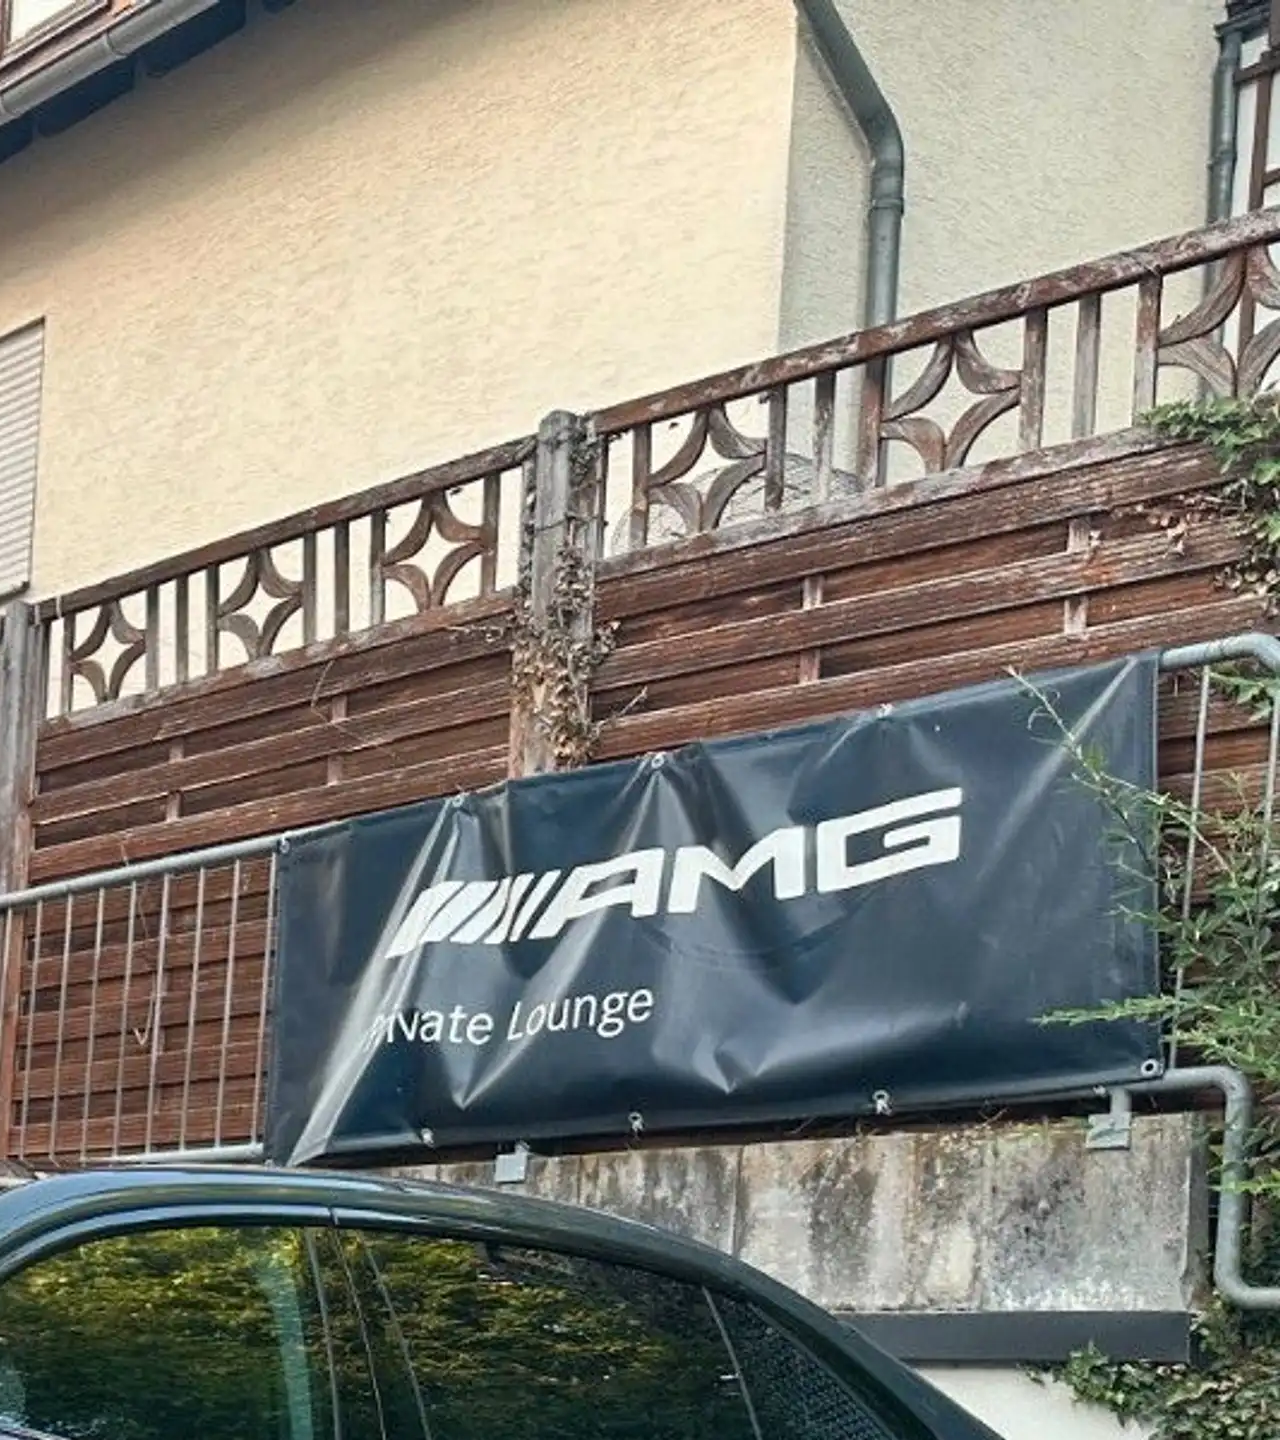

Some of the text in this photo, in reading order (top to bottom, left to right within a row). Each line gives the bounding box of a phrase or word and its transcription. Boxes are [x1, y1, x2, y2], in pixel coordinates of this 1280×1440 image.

[528, 787, 962, 940] AMG
[364, 988, 654, 1051] ivate Lounge
